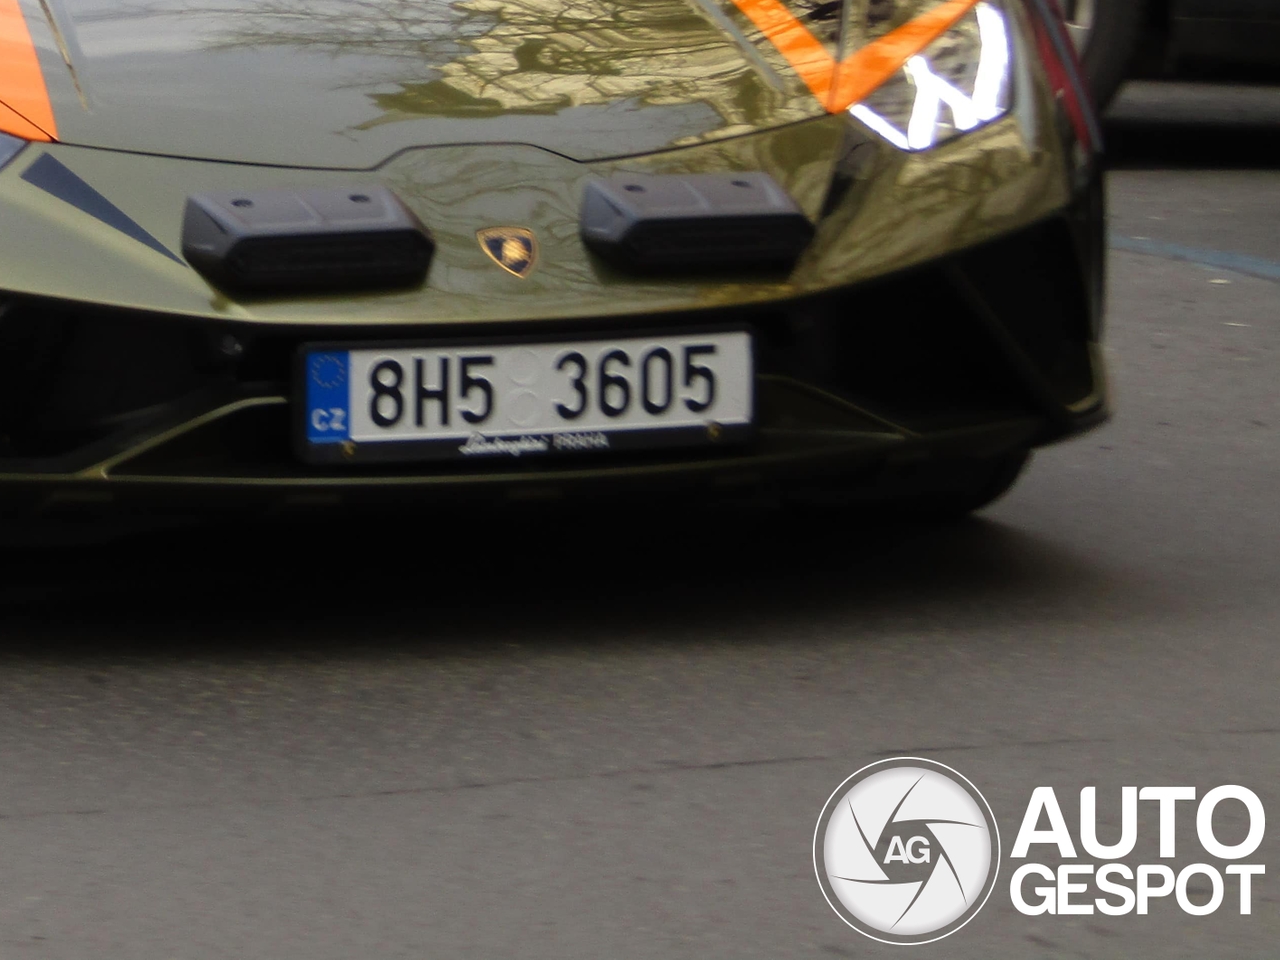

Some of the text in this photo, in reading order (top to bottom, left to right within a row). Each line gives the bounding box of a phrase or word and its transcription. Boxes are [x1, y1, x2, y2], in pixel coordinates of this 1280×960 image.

[368, 343, 718, 428] 8H5 3605
[311, 408, 346, 431] CZ
